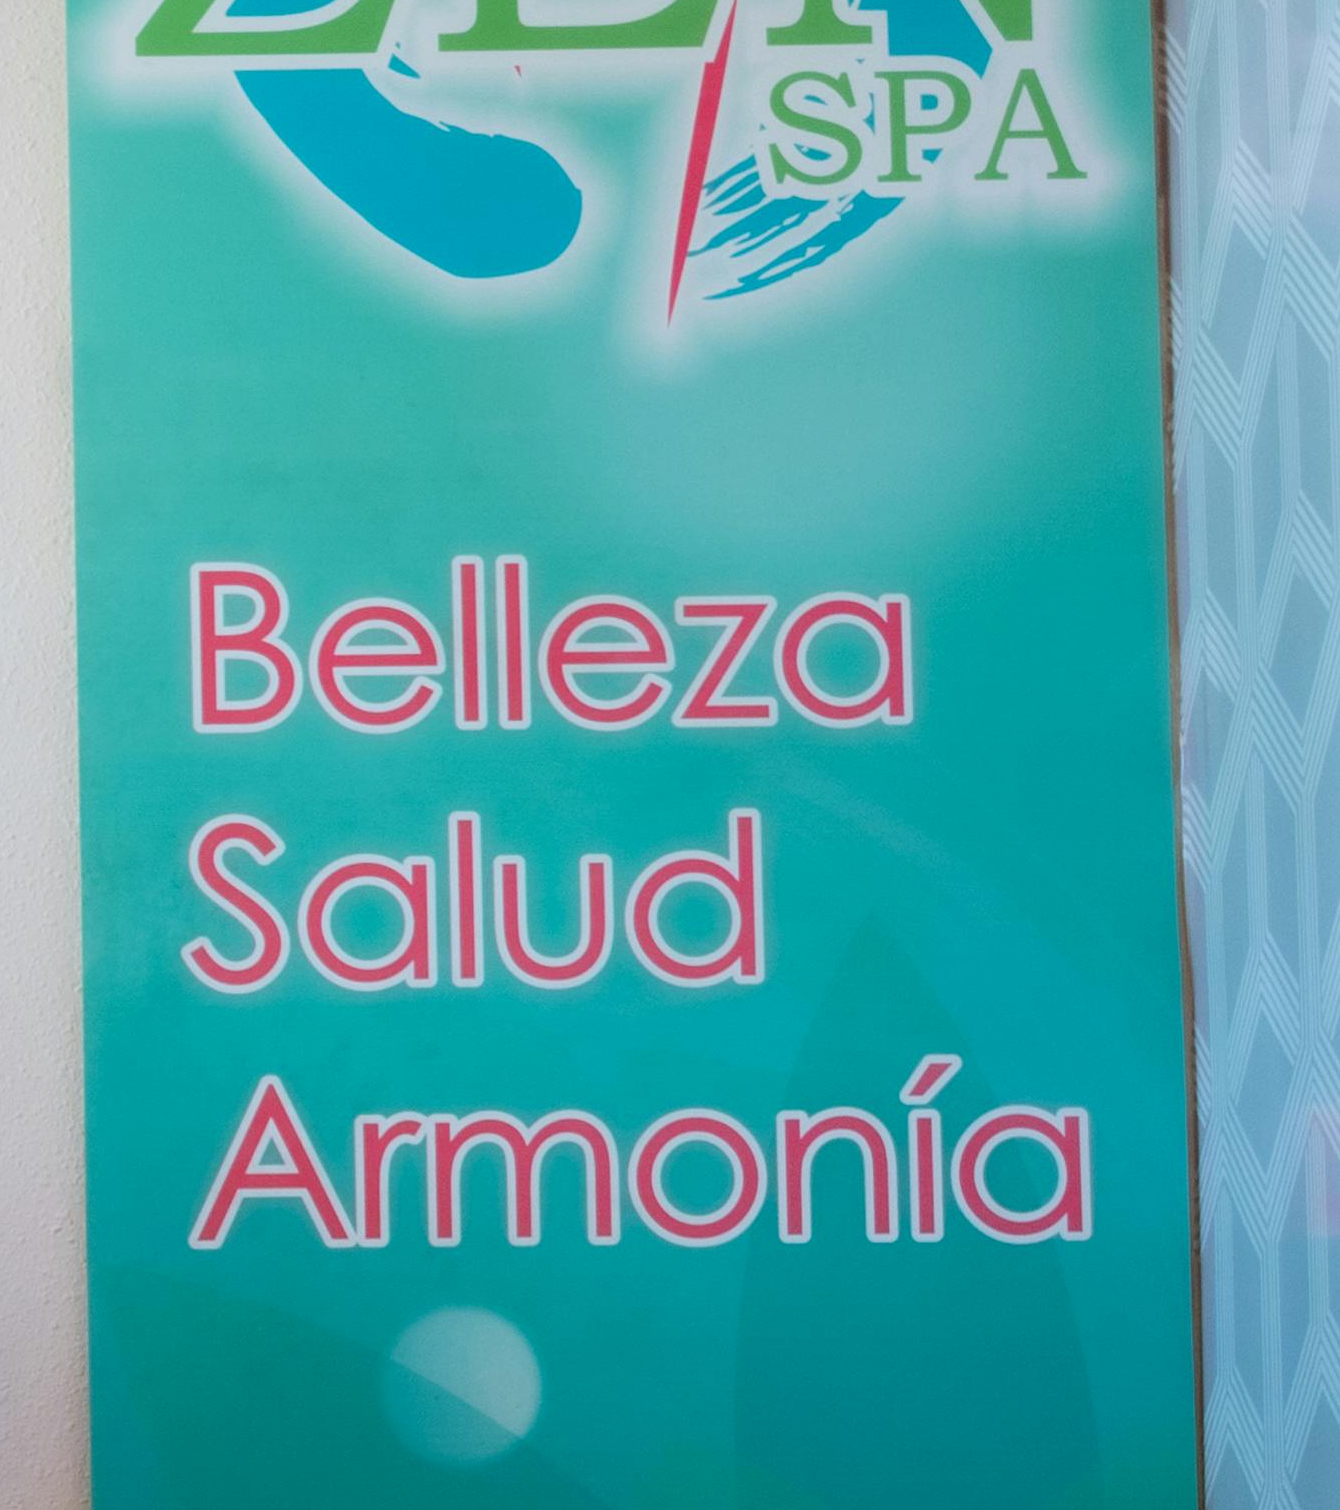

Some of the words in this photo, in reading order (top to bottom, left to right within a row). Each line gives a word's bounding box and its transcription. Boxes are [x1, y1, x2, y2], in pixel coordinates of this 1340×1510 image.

[766, 67, 1089, 187] SPA
[189, 554, 914, 734] Belleza
[181, 808, 765, 994] Salud
[187, 1053, 1093, 1250] Armonía
